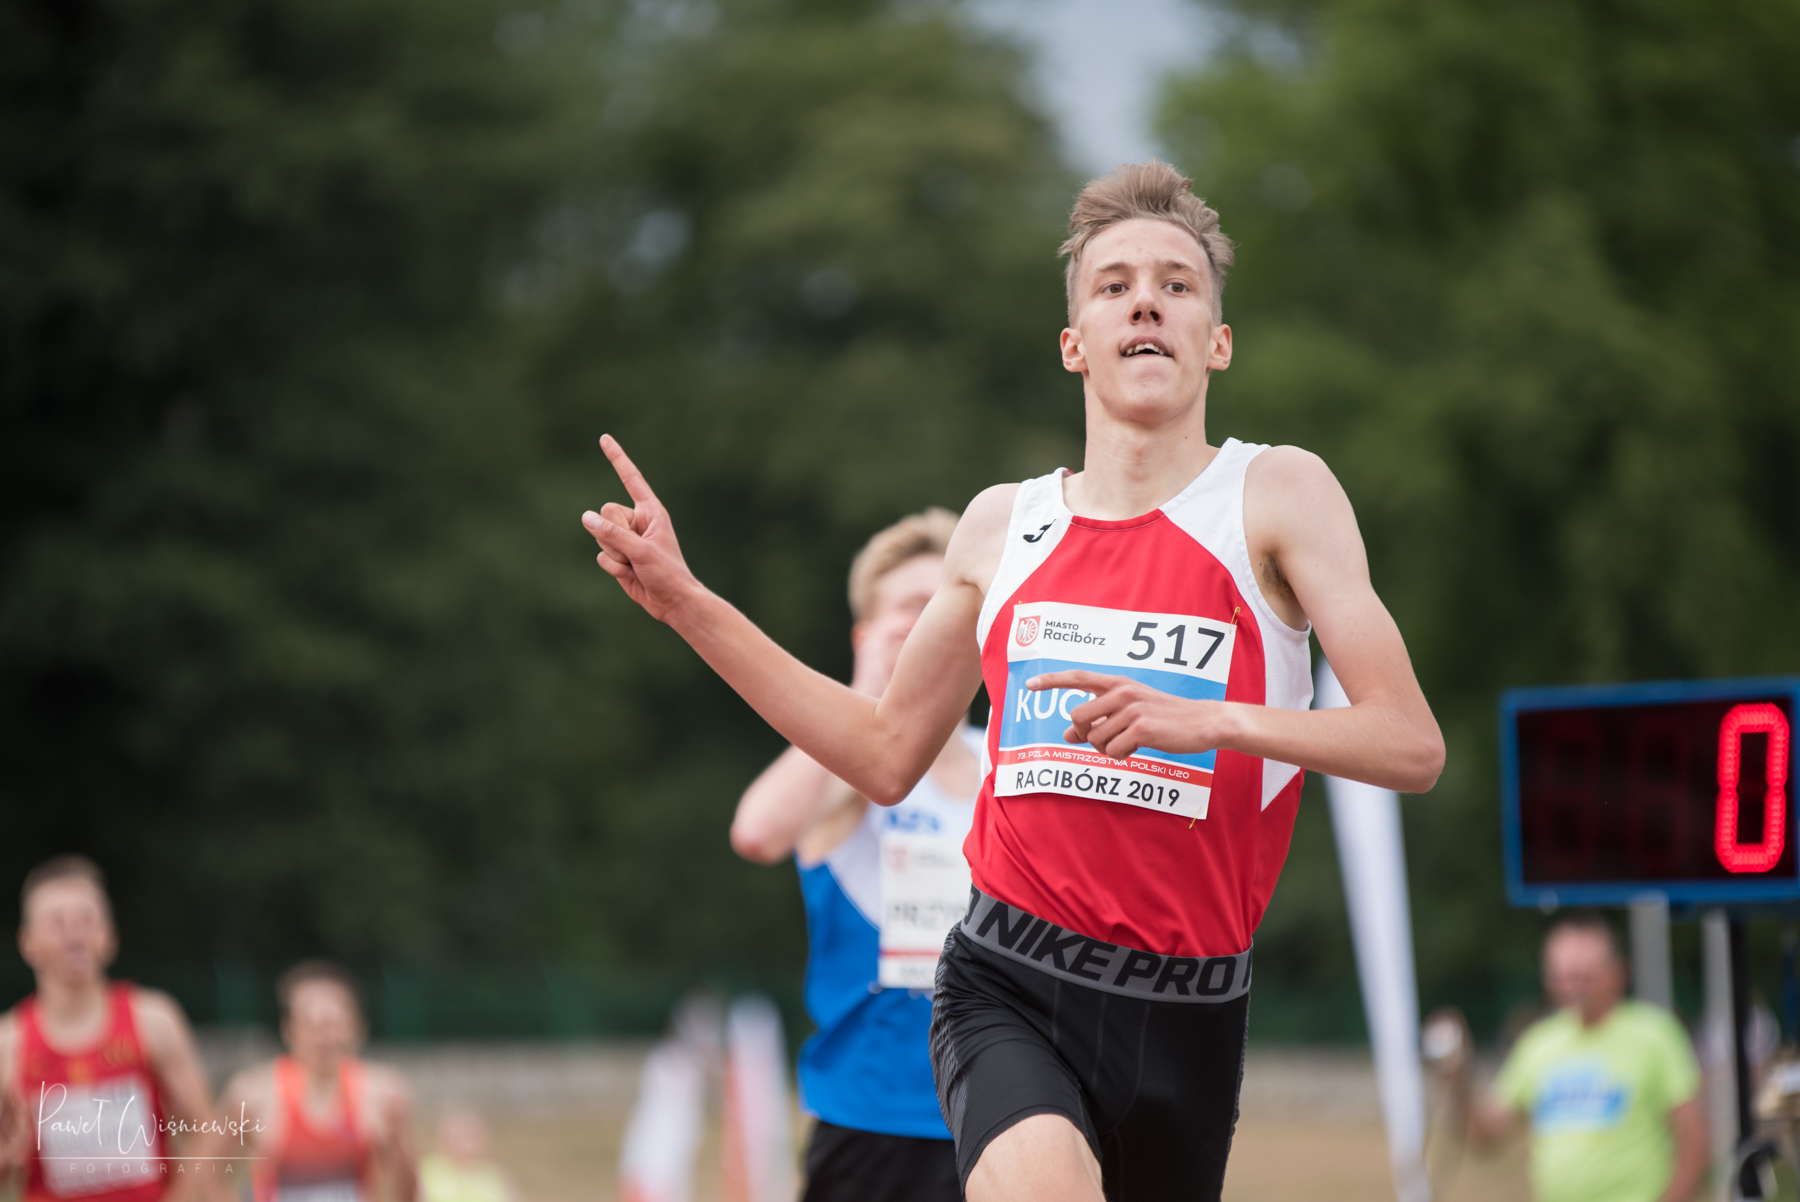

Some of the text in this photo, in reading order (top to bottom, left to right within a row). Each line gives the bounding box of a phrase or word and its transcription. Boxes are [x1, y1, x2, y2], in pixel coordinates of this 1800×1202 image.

[1043, 628, 1106, 646] Racibórz
[1045, 620, 1079, 631] MIASTO
[1126, 621, 1225, 670] 517
[1015, 688, 1097, 723] KUC
[1028, 750, 1050, 759] PZLA
[1052, 751, 1129, 768] MISTRZOSTWA
[1130, 761, 1167, 775] POLSKI
[1168, 768, 1190, 780] U20
[1015, 768, 1181, 808] RACIBÓRZ 2019
[1714, 702, 1790, 873] 0
[975, 900, 1119, 982] NIKE
[1112, 948, 1237, 997] PRO
